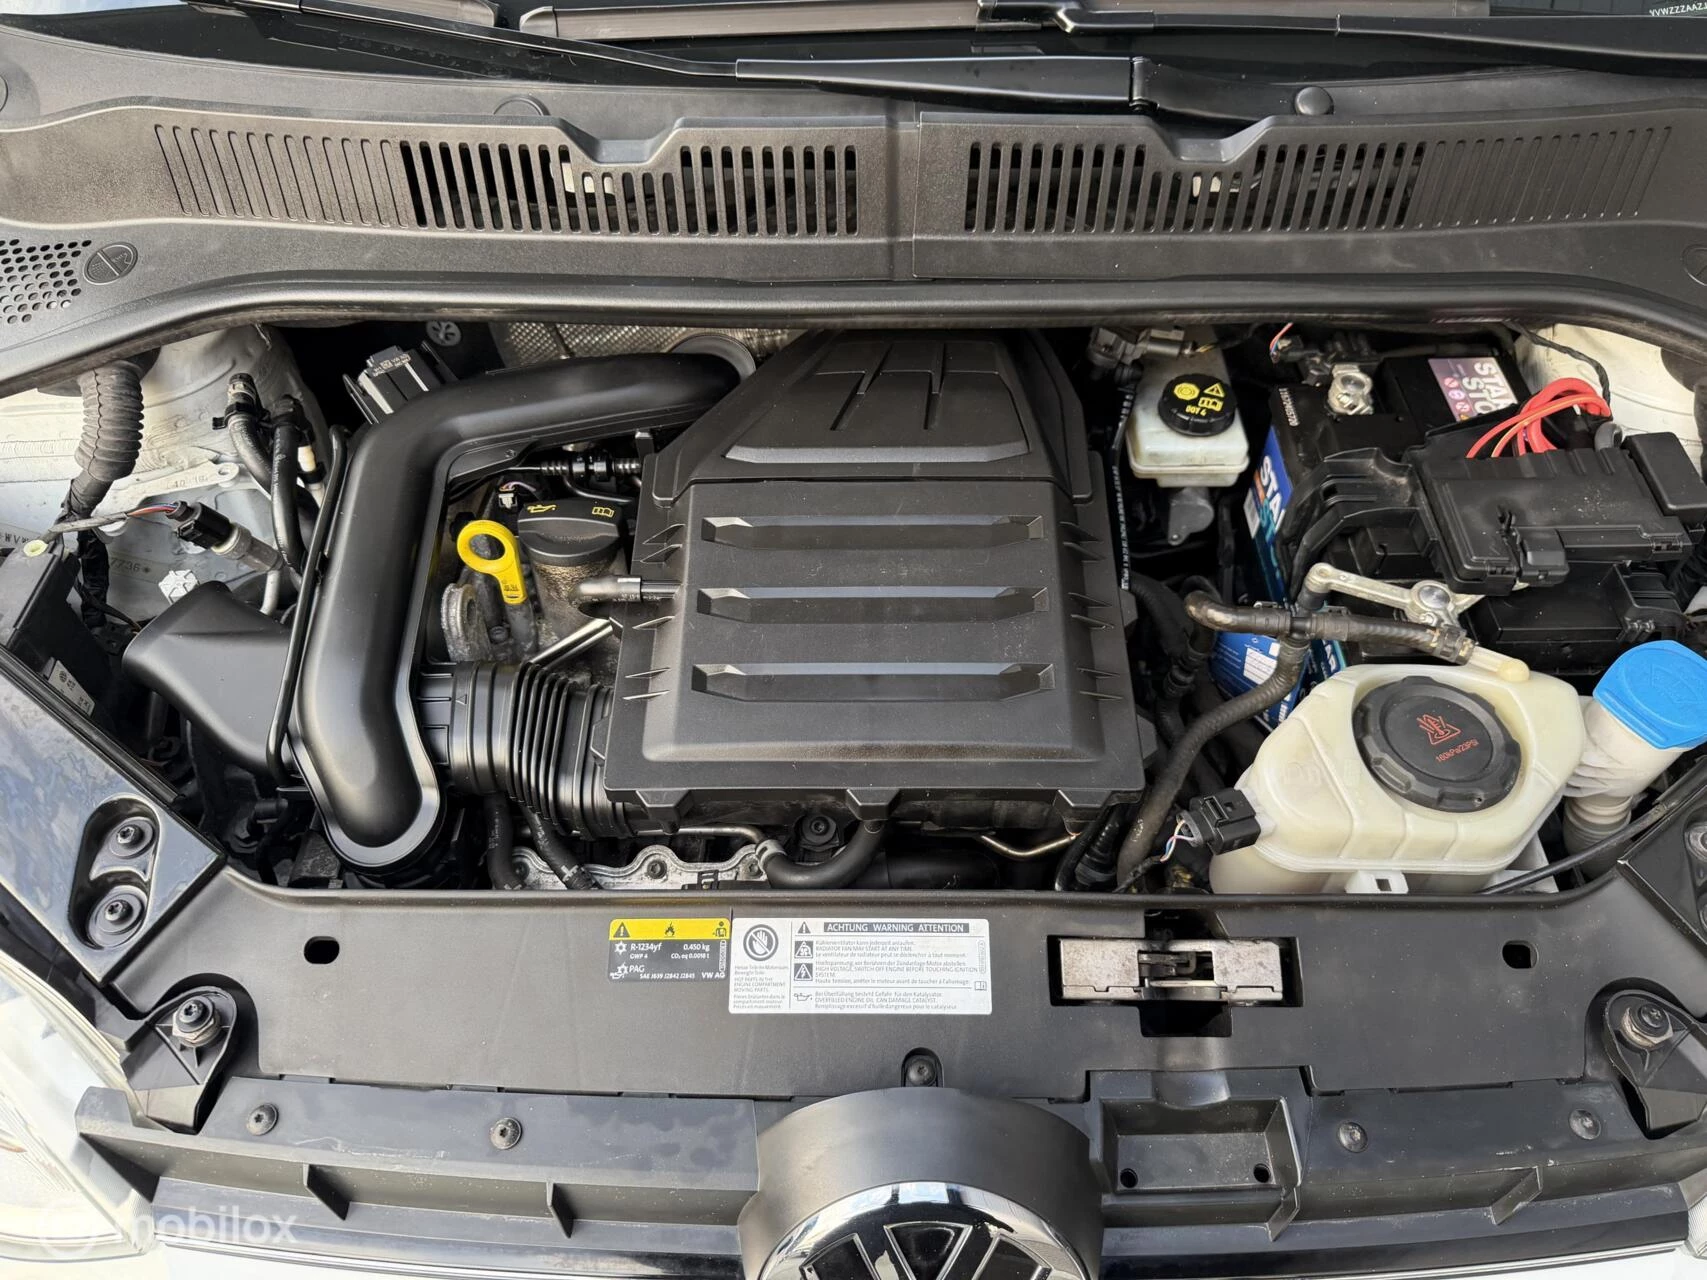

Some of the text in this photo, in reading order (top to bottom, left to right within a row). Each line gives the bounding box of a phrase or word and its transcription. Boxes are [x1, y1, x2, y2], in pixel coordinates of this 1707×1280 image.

[827, 923, 964, 933] ACHTUNG WARNING ATTENTION
[630, 943, 710, 953] R-1234yf 0.450 kg
